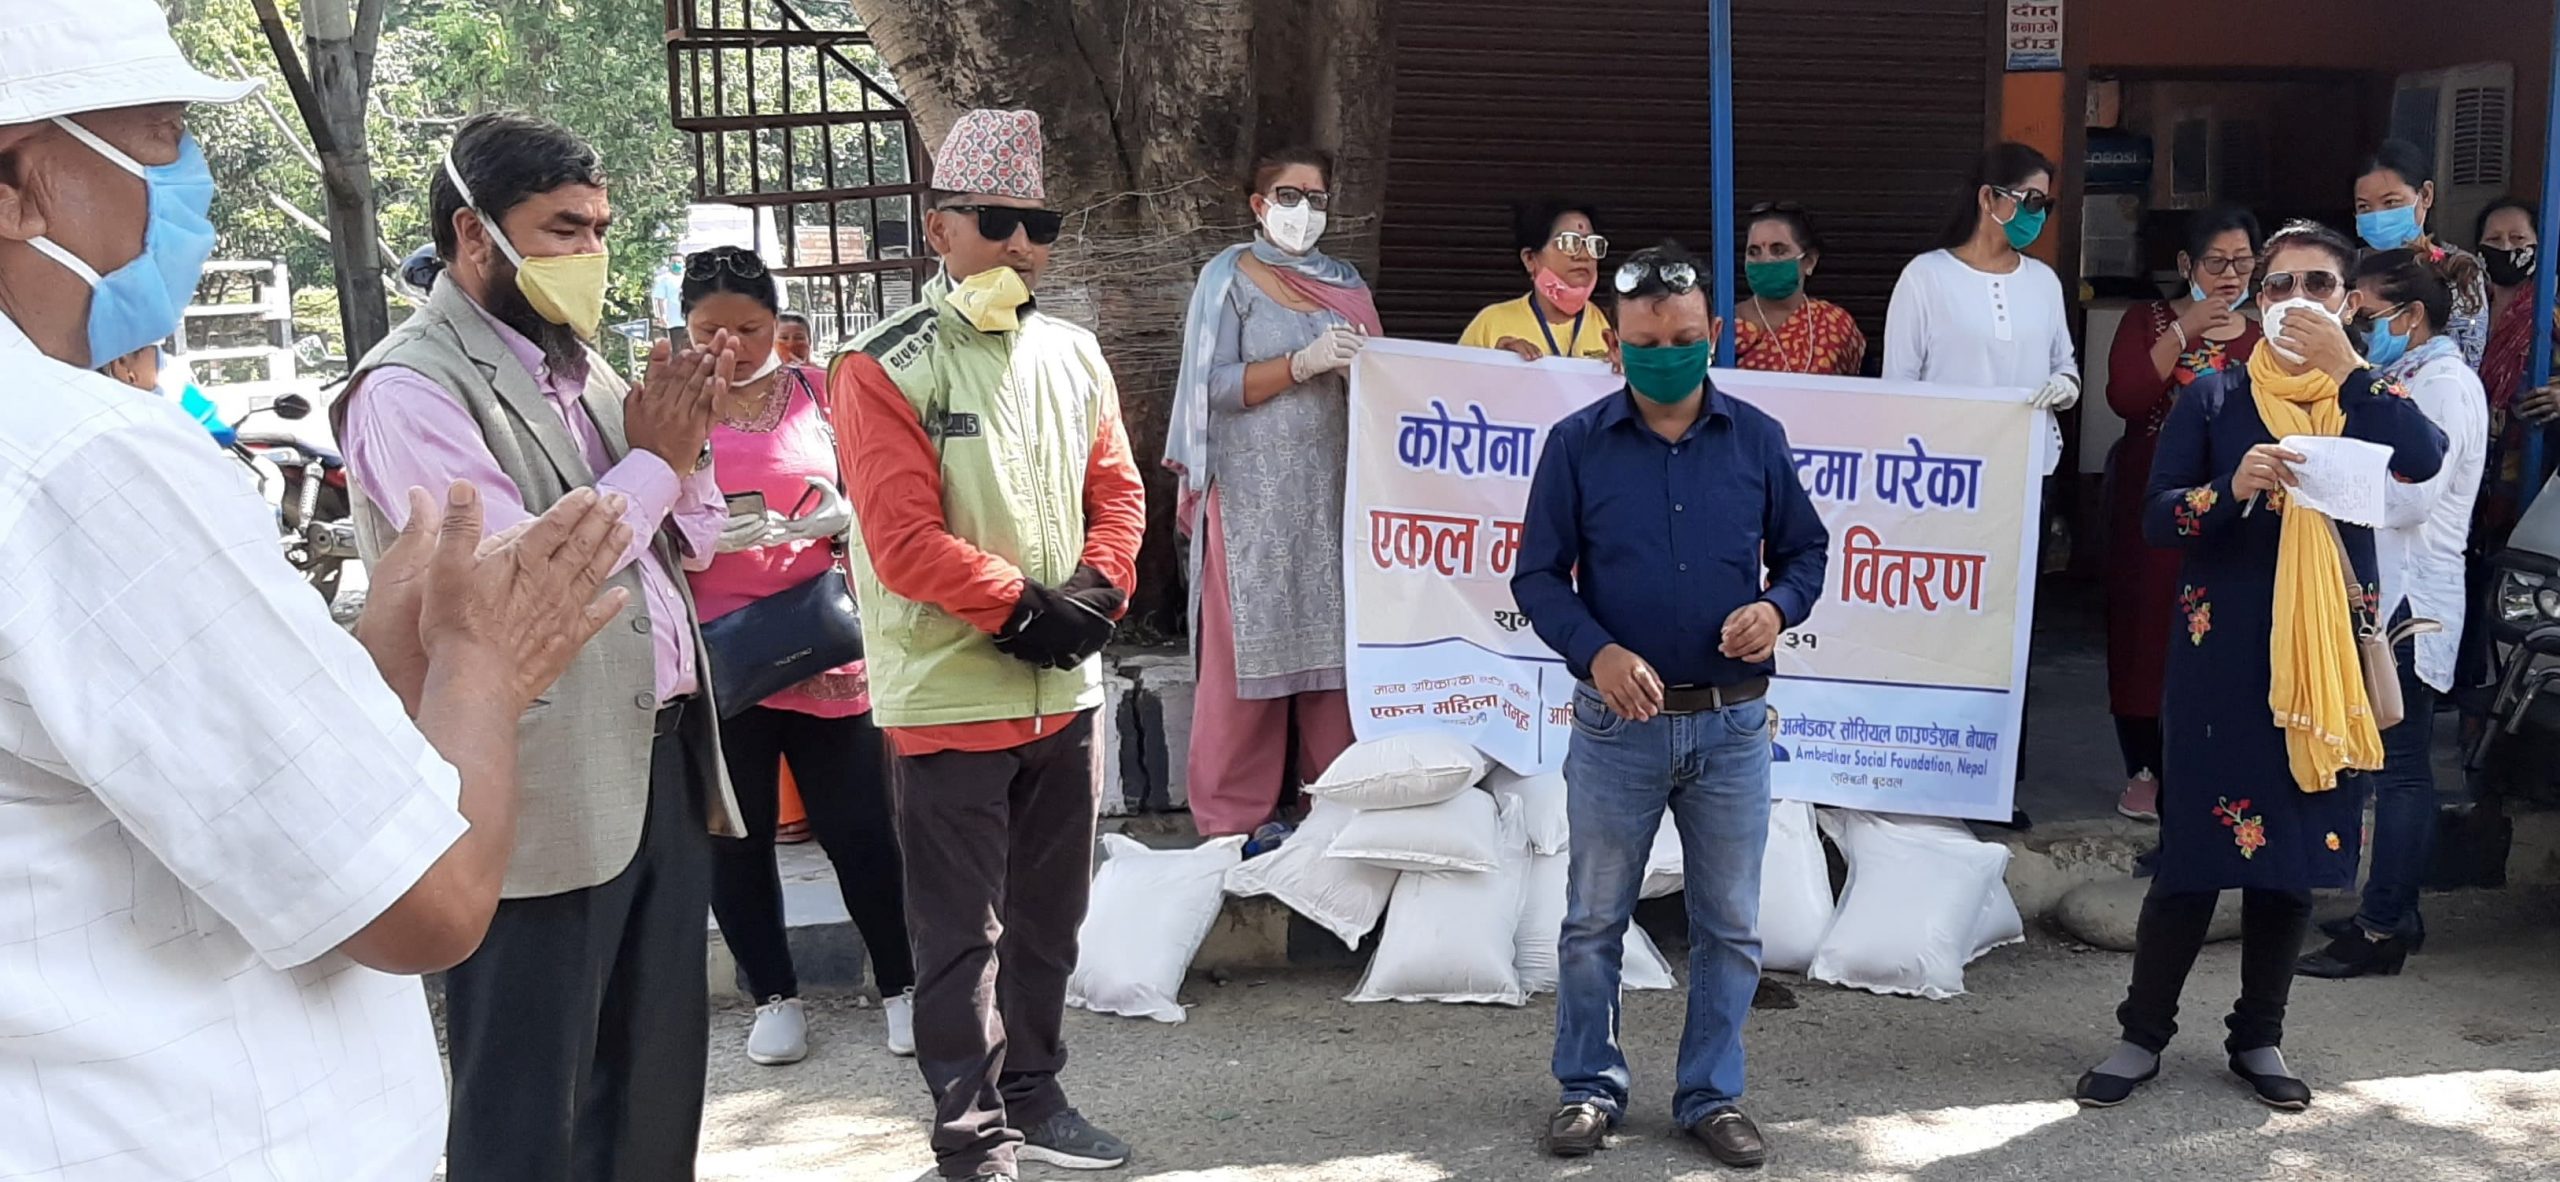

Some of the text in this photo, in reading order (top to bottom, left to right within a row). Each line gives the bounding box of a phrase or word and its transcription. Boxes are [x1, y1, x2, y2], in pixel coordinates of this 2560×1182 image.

[2091, 151, 2137, 168] pepsi
[1400, 401, 1982, 508] कोरोना टमा परेका
[1370, 510, 1986, 611] एकल म वितरण
[1370, 703, 1426, 719] एकल
[1433, 694, 1498, 715] महिला
[1966, 725, 1998, 751] नेपाल
[1795, 746, 1988, 778] Ambedkar Social Foundation, Nepal
